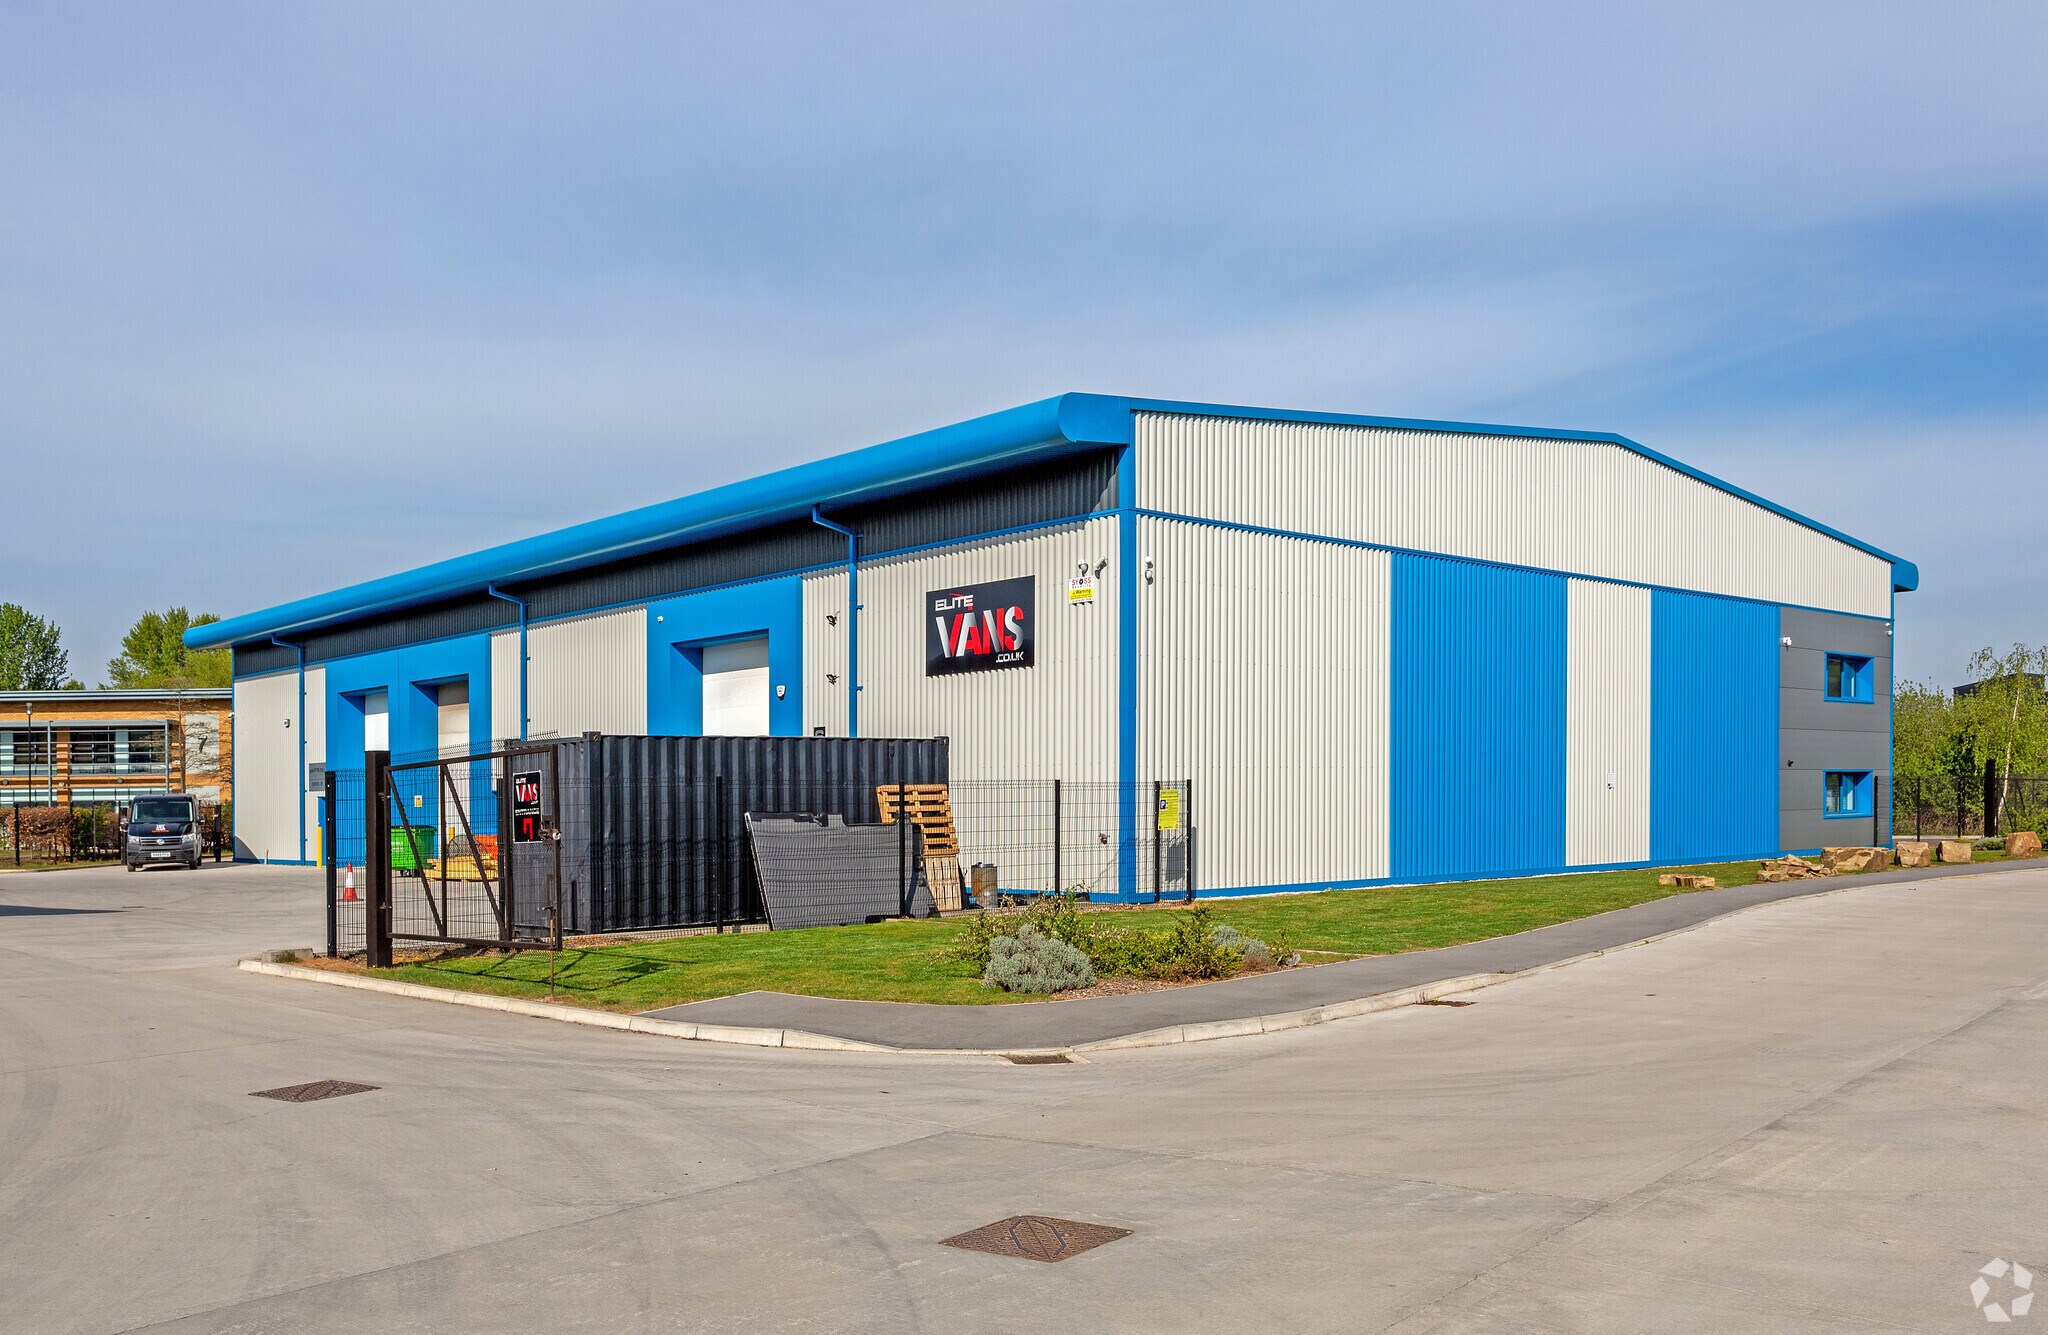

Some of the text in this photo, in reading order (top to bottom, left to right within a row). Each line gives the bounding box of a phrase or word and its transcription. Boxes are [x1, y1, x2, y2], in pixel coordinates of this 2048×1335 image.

[935, 595, 974, 611] ELITE
[935, 606, 1025, 658] VANS
[995, 651, 1025, 663] .CO.UK
[198, 736, 208, 753] 7
[516, 783, 539, 802] VANS
